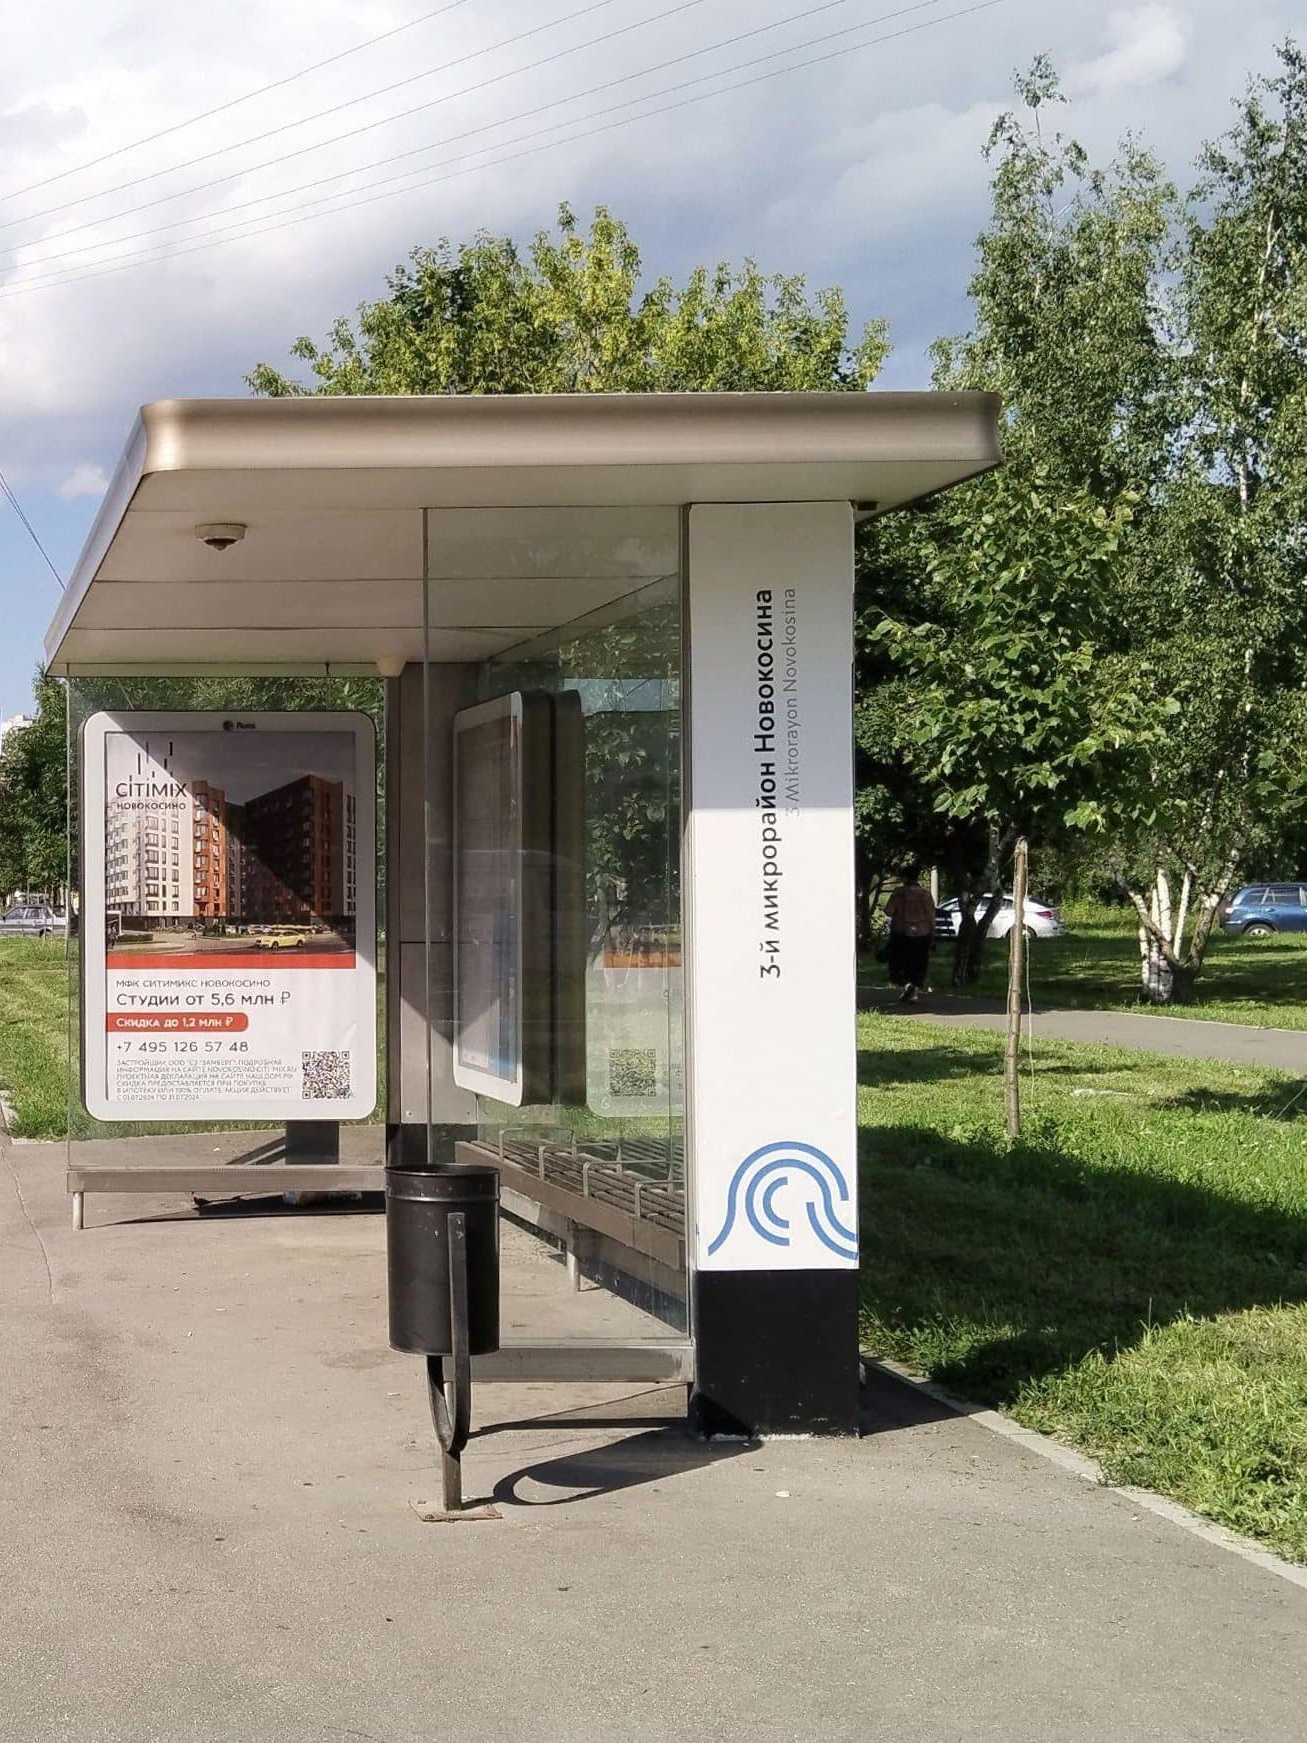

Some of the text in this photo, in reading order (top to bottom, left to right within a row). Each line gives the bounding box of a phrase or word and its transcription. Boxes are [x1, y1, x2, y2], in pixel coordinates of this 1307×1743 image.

[780, 587, 797, 693] Novokosina
[783, 697, 804, 800] Mikrorayon
[754, 588, 782, 979] 3-й микрорайон Новокосина
[117, 802, 187, 811] НОВОКОСИНО
[116, 980, 271, 988] МФК СИТИМИКС НОВОКОСИНО
[211, 993, 235, 1007] 5,6
[116, 1041, 249, 1052] +7 495 126 57 48
